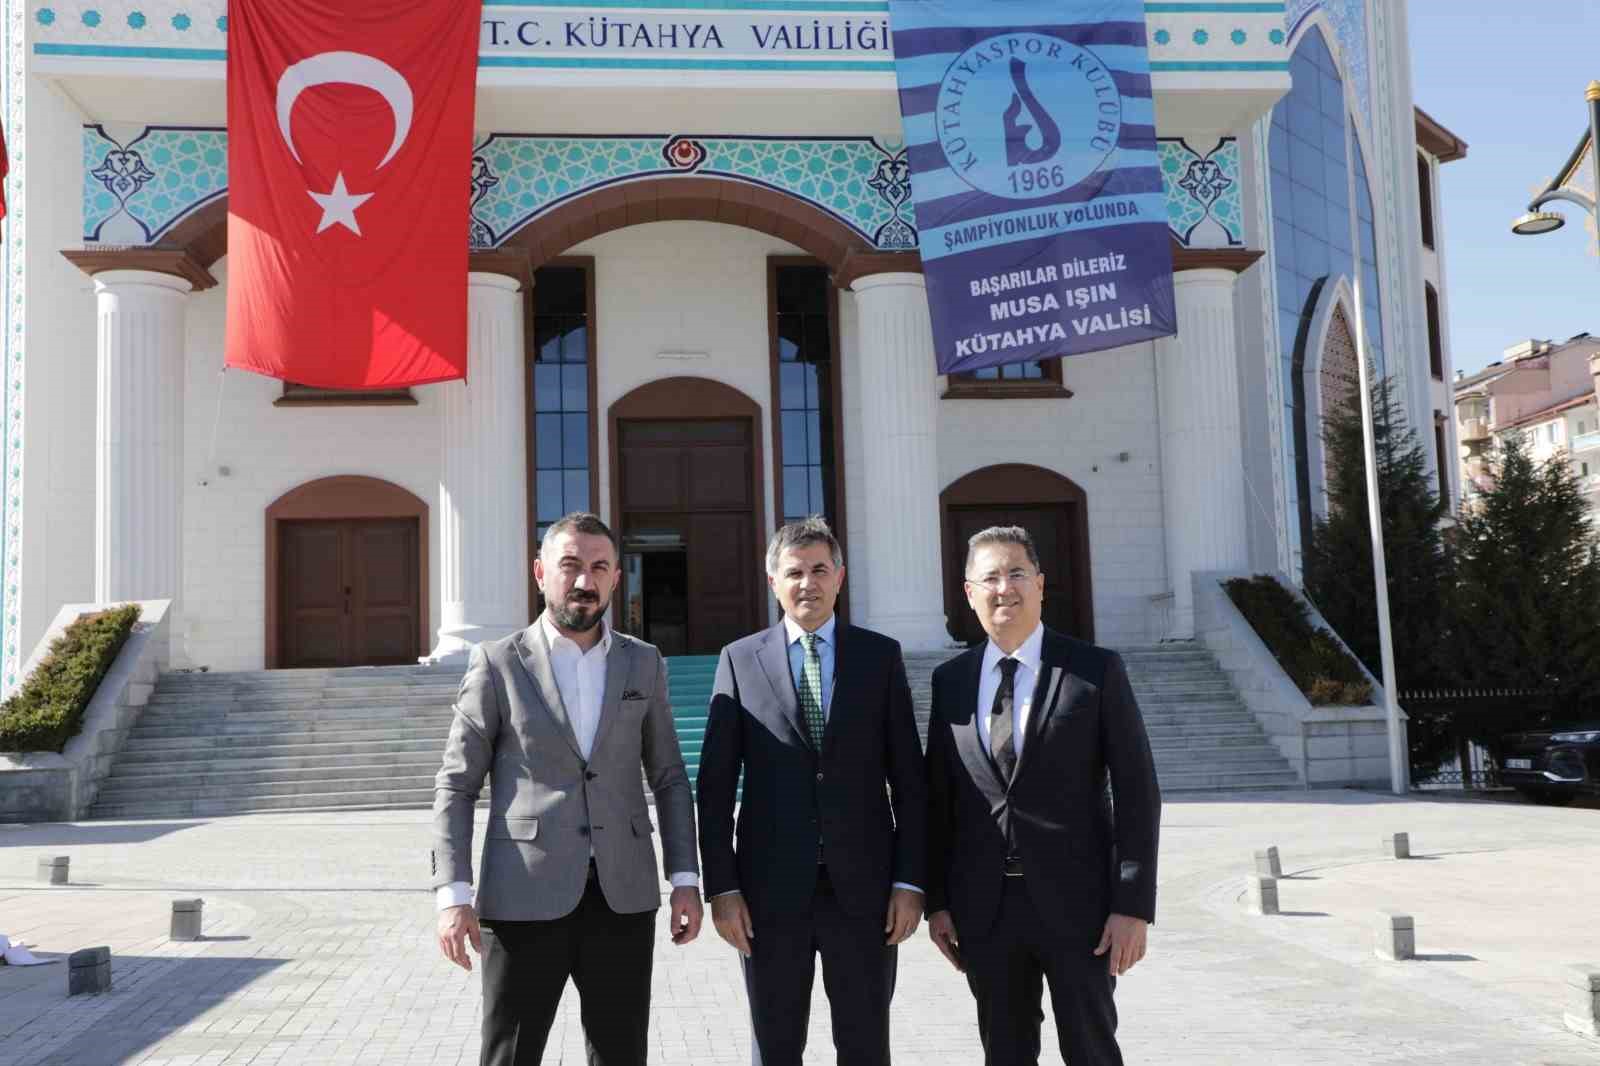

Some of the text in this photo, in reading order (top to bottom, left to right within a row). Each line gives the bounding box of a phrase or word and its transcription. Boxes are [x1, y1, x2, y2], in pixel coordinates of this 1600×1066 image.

[565, 17, 725, 49] KÜTAHYA
[750, 19, 889, 50] VALİLİĞİ
[1008, 165, 1064, 193] 1966
[944, 200, 1139, 249] ŞAMPİYONLUK YOLUNDA
[970, 252, 1127, 297] BAŞARILAR DİLERİZ
[990, 282, 1117, 321] MUSA IŞIN
[955, 304, 1152, 357] KÜTAHYA VALİSİ
